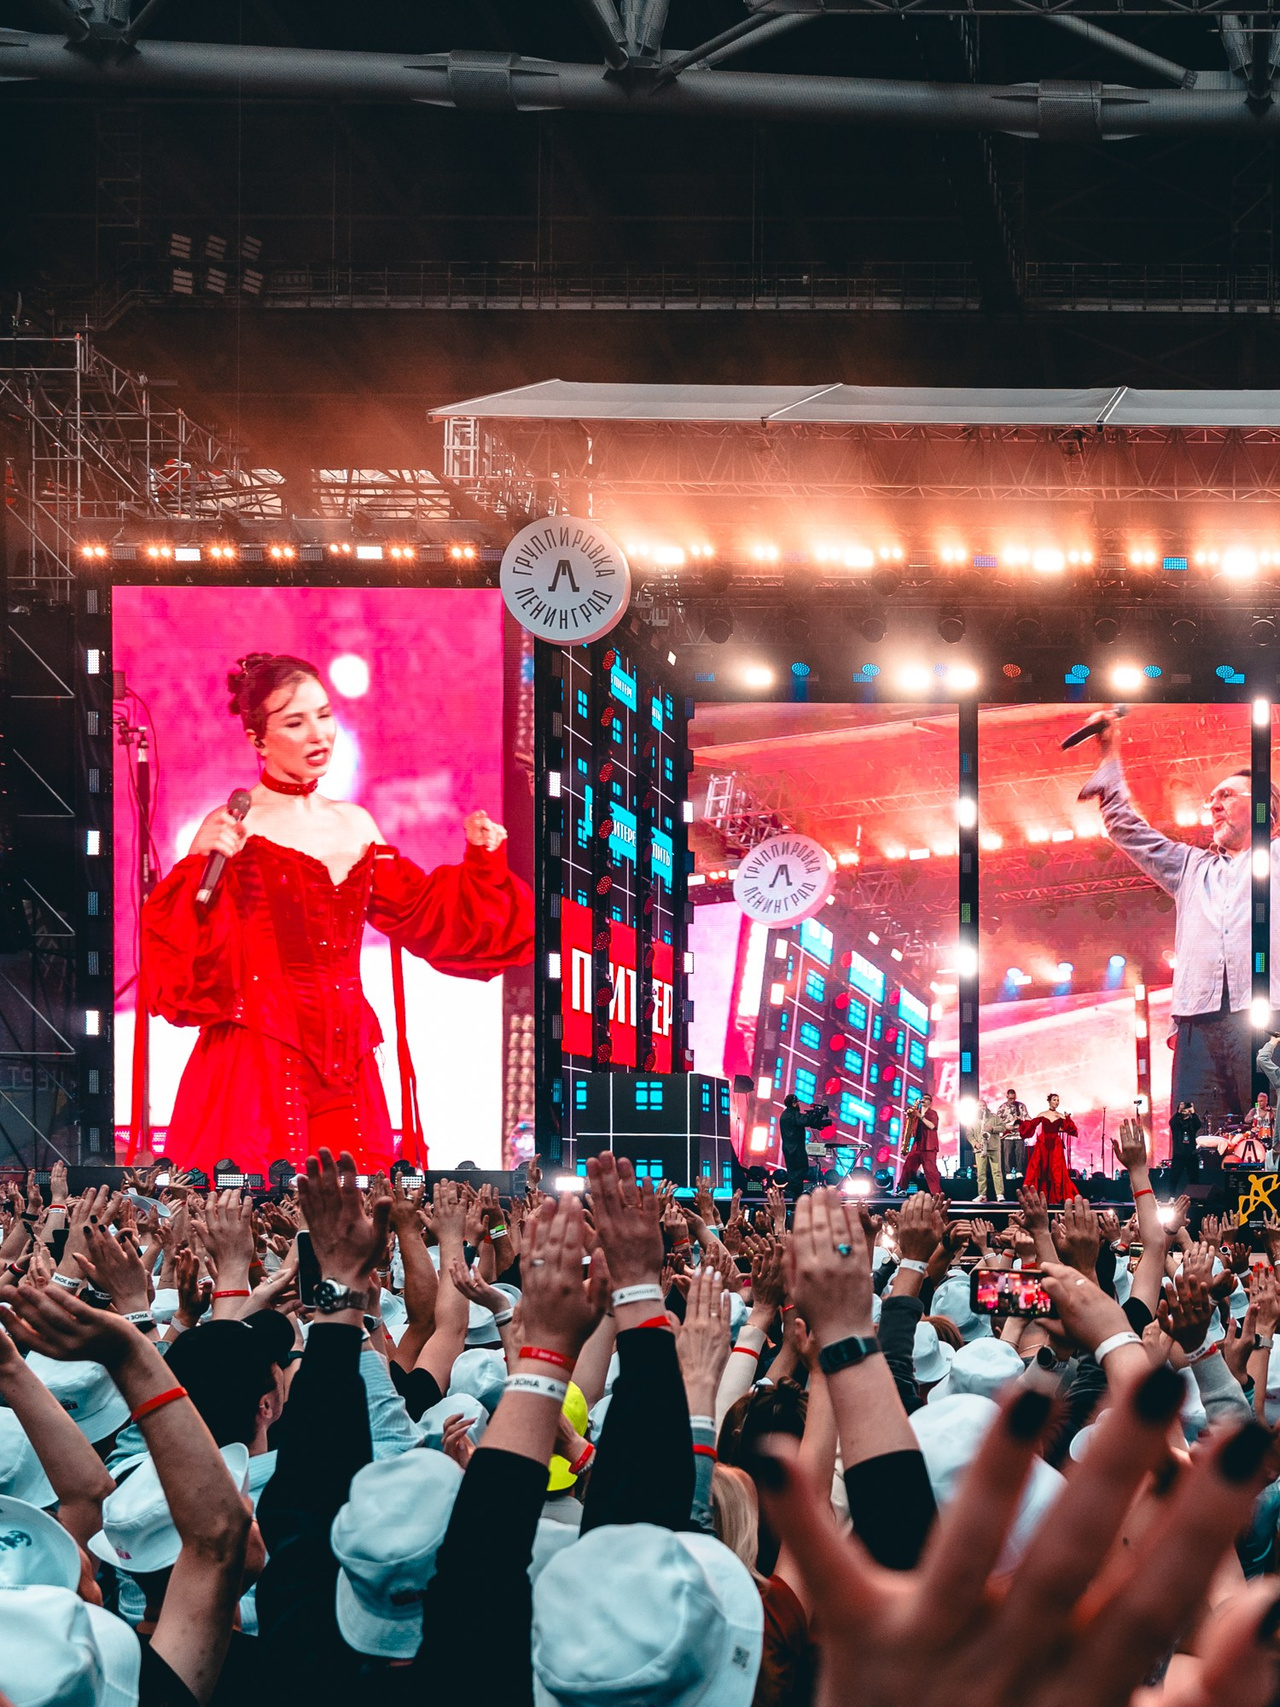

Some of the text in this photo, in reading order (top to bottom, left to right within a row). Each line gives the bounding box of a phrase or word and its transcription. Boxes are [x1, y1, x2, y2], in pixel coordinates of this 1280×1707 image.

[512, 527, 615, 578] ГРУППИРОВКА
[514, 587, 613, 629] ЛЕНИНГРАД
[744, 842, 821, 878] ГРУППИРОВКА
[743, 882, 817, 913] ЛЕНИНГРАД
